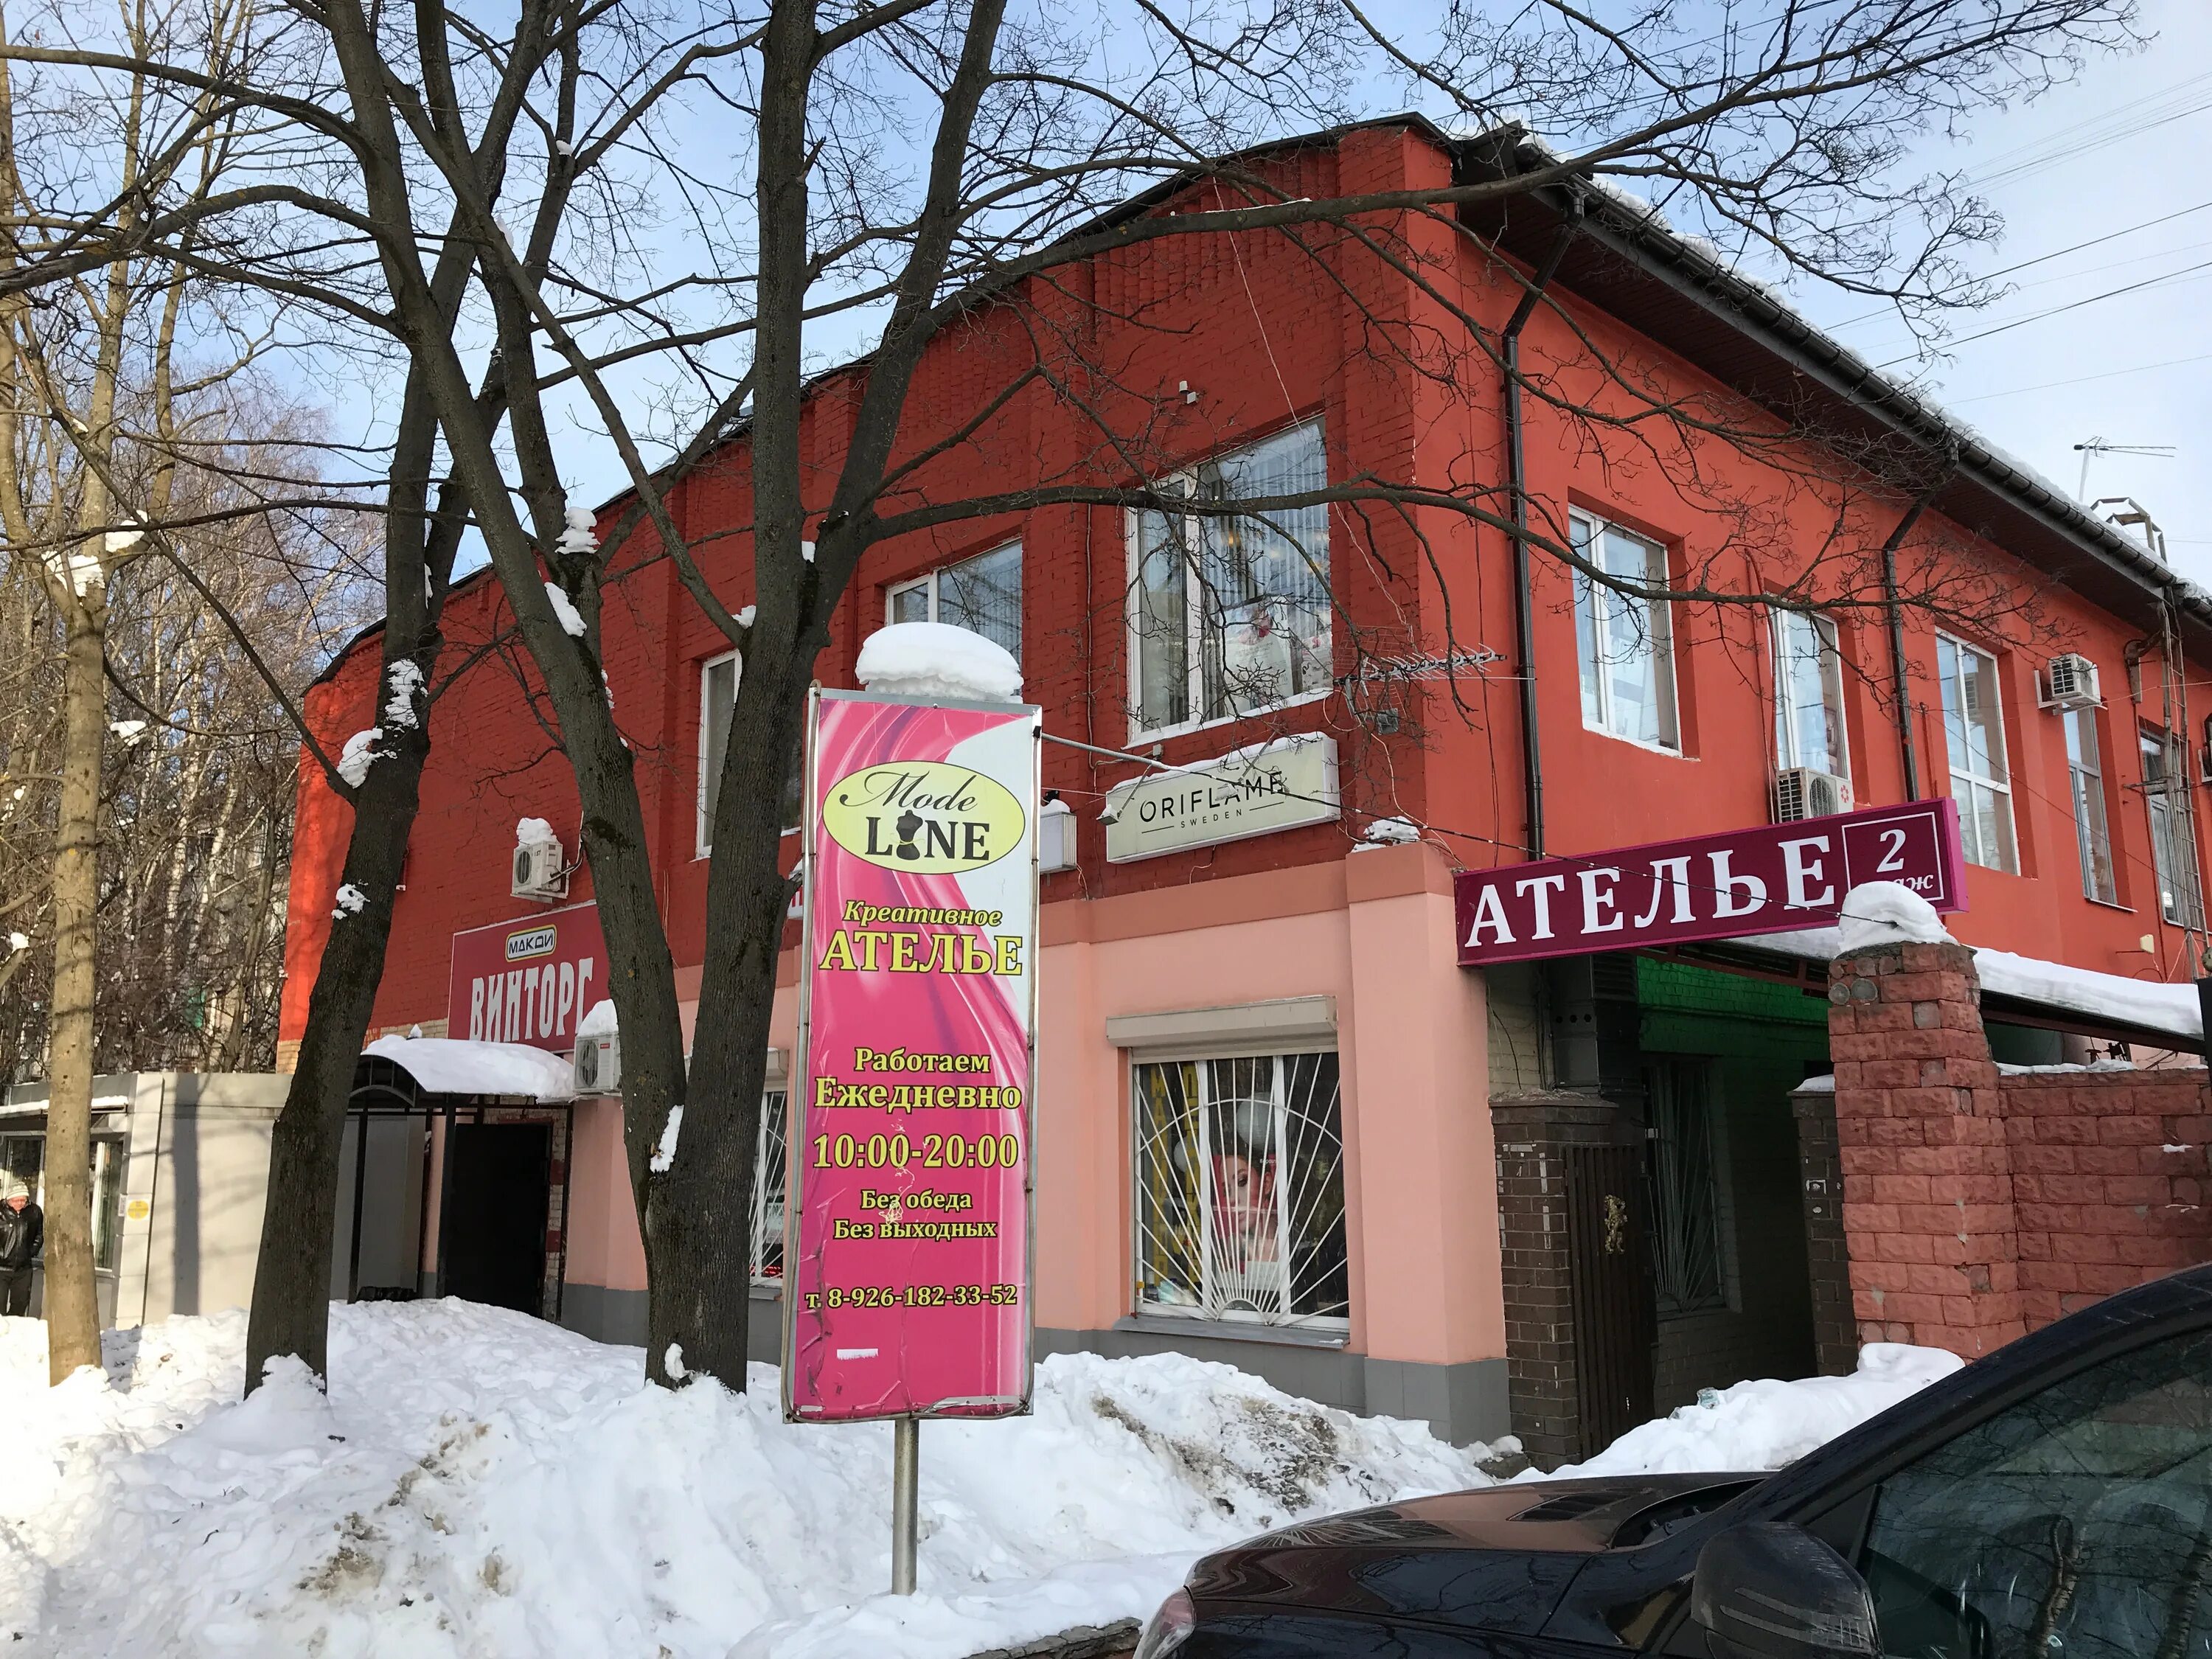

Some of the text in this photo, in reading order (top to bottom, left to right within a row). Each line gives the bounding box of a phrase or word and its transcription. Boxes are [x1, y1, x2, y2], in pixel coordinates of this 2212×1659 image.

[839, 770, 978, 812] Mode
[1180, 809, 1242, 829] SWEDEN
[1876, 829, 1906, 873] 2
[1464, 835, 1835, 948] АТЕЛЬЕ
[842, 900, 1004, 928] Креативное
[509, 933, 553, 954] МАКДИ
[818, 930, 1023, 976] АТЕЛЬЕ
[469, 956, 594, 1043] ВИНТОРГ
[854, 1046, 992, 1074] Работаем
[814, 1077, 1022, 1114] Ежедневно
[812, 1133, 1019, 1169] 10:00-20:00
[860, 1189, 973, 1212] Без обеда
[833, 1219, 998, 1242] Без выходных
[827, 1284, 1018, 1307] 8-926-182-33-52
